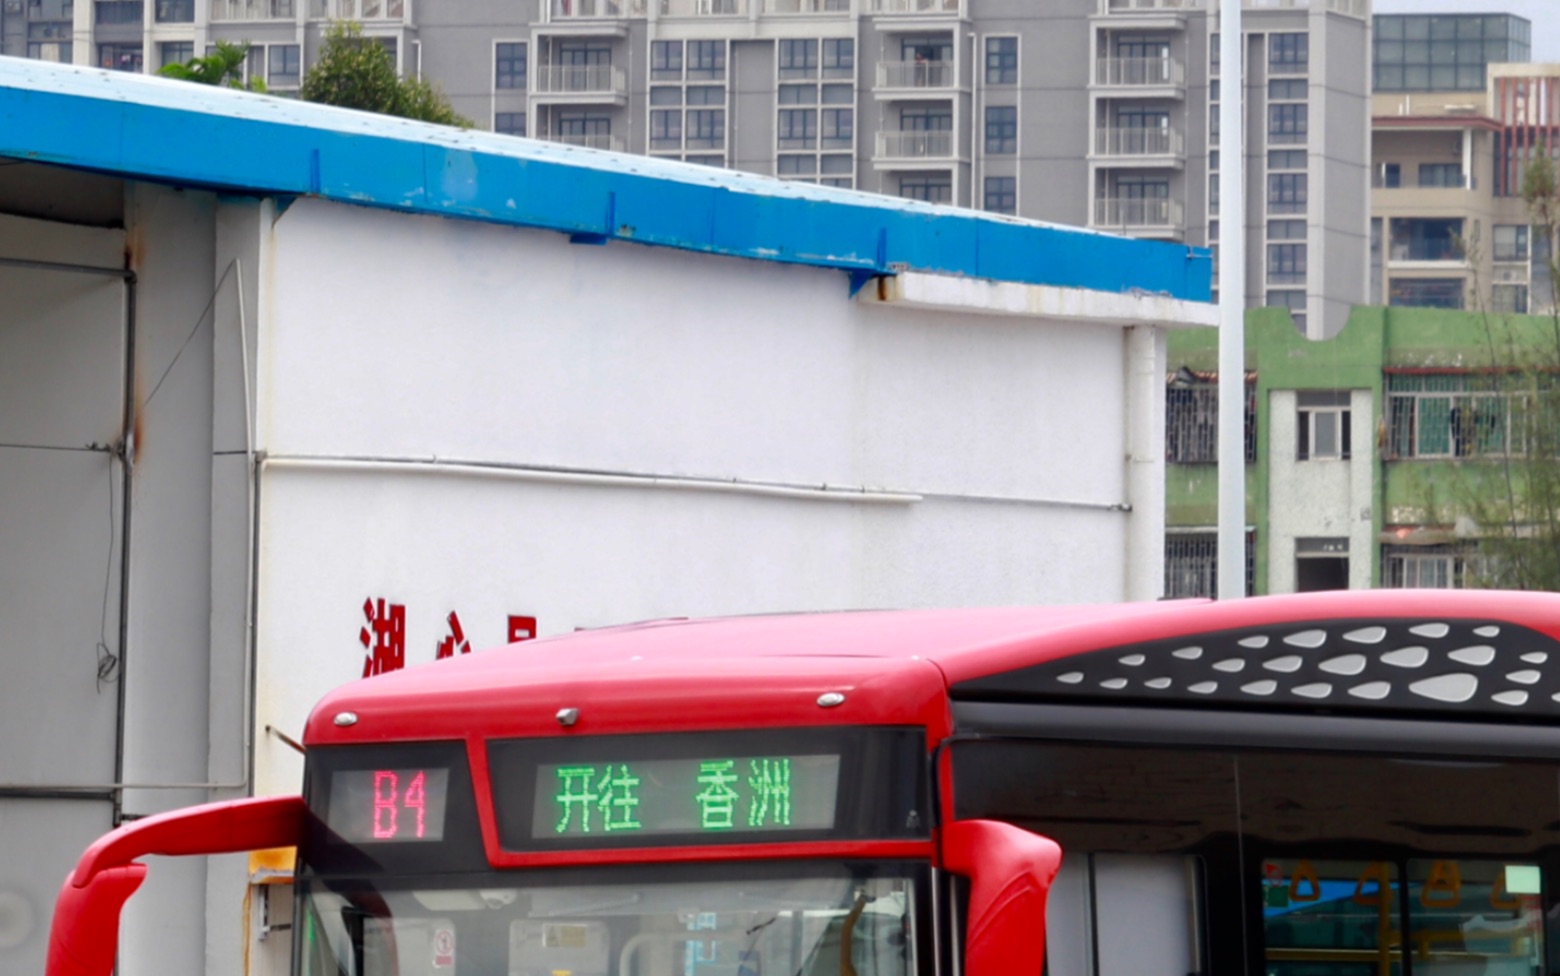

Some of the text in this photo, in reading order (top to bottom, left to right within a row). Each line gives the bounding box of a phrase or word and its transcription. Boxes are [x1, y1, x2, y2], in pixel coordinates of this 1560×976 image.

[373, 770, 425, 838] B4
[556, 759, 789, 832] 开往 香洲
